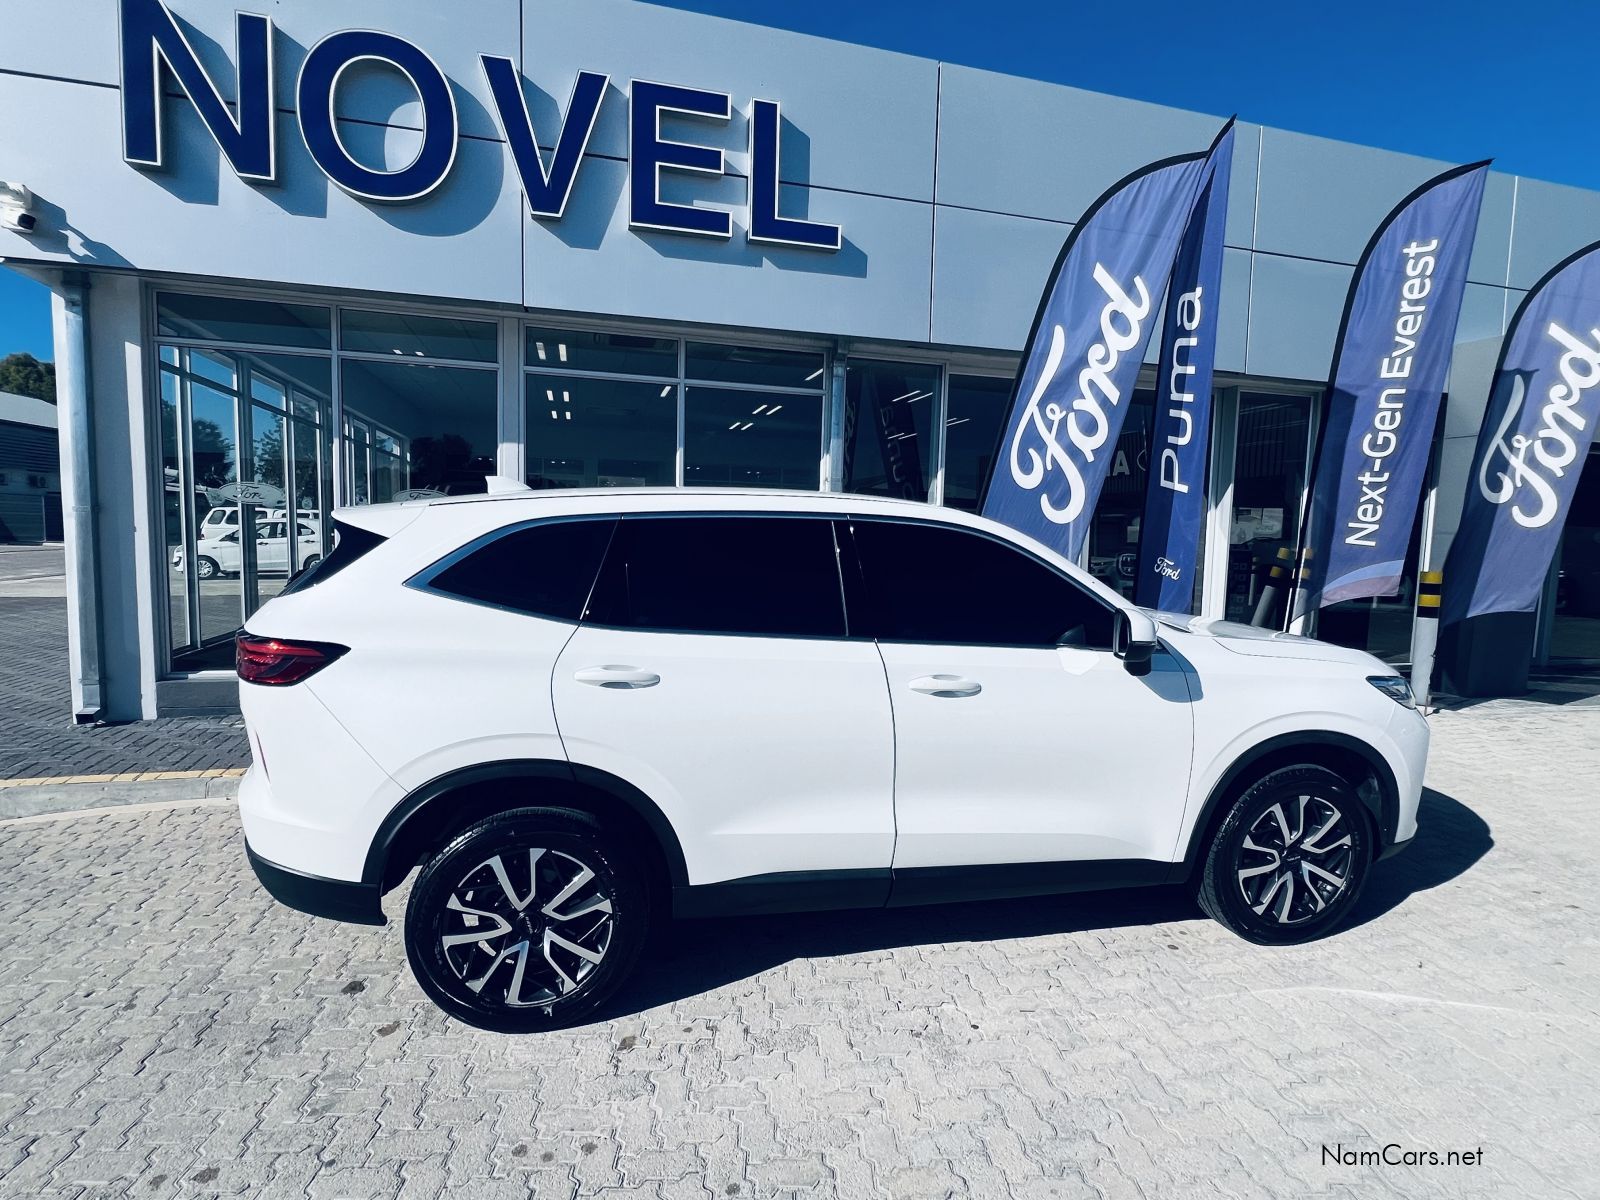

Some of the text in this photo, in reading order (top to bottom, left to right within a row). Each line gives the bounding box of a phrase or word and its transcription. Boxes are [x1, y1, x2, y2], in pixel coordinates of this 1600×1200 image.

[118, 0, 842, 251] NOVEL
[232, 485, 266, 500] For
[1010, 262, 1150, 524] Ford
[1159, 285, 1204, 494] Puma
[1345, 238, 1438, 548] Next-Gen Everest
[1154, 556, 1181, 581] Ford
